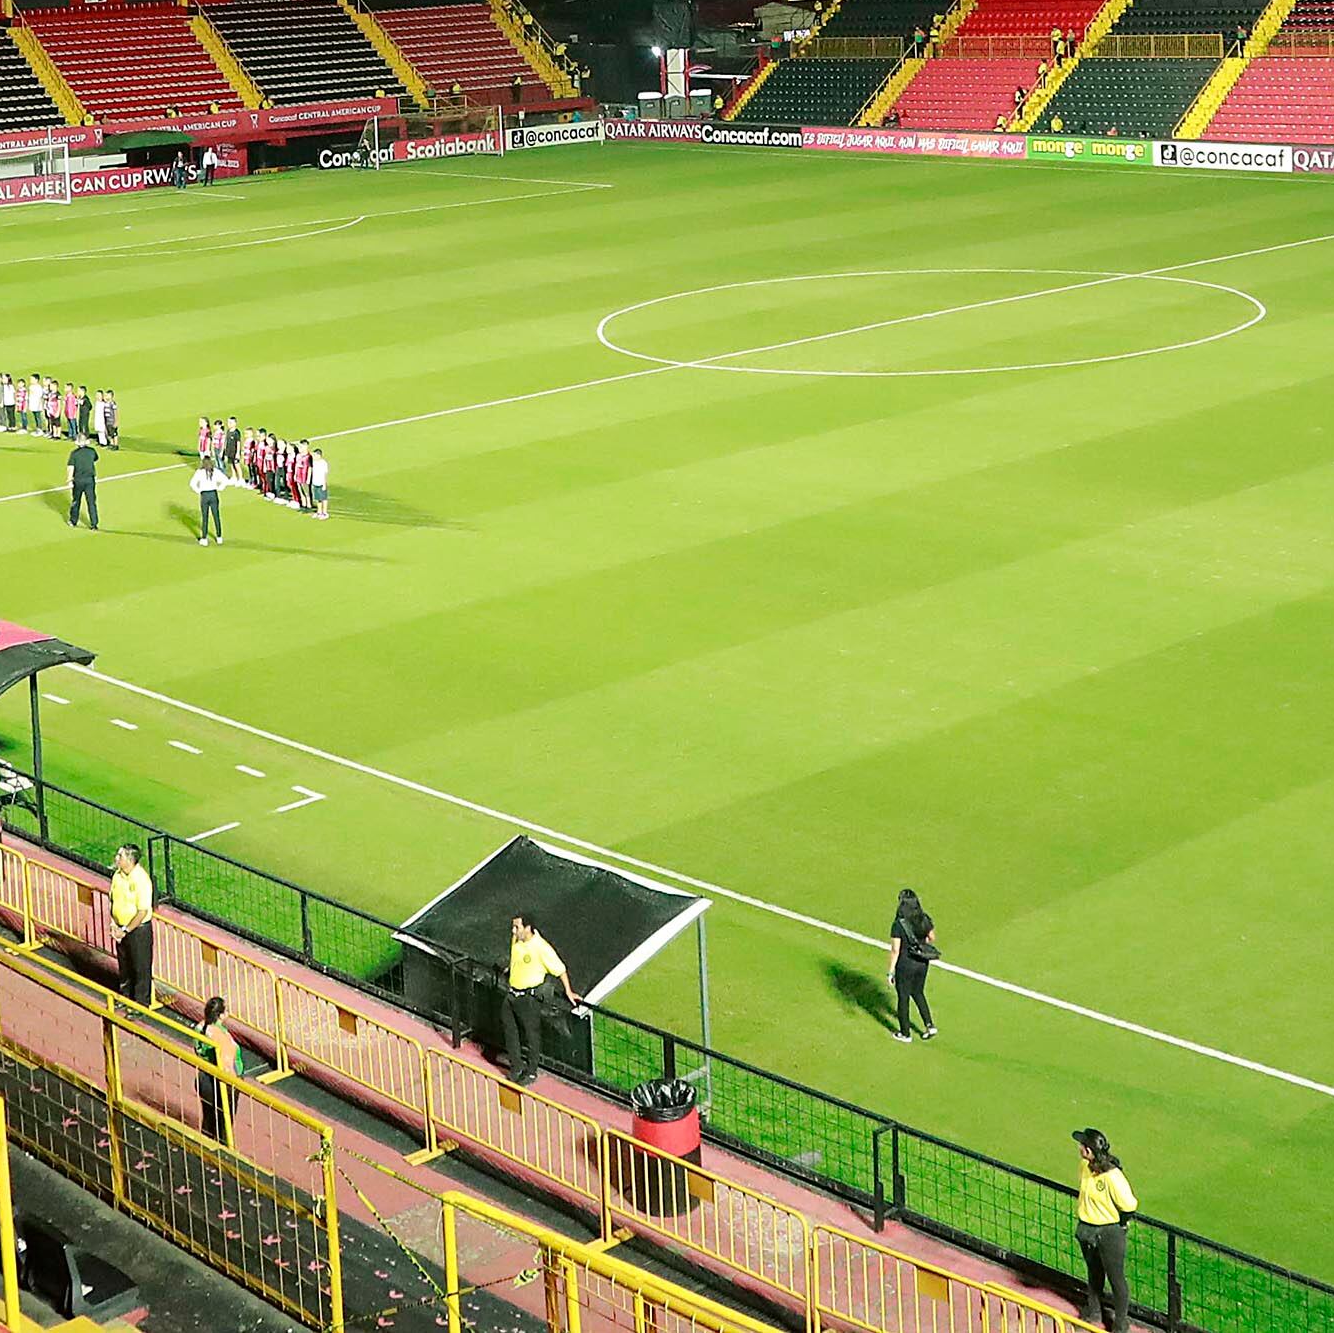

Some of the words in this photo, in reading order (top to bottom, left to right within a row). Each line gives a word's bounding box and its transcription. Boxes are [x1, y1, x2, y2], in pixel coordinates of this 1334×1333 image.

[298, 110, 330, 120] CENTRAL
[331, 107, 366, 116] AMERICAN
[367, 105, 381, 113] CUP
[183, 121, 220, 131] AMERICAN
[222, 120, 237, 129] CUP
[525, 122, 601, 146] @concacaf
[605, 122, 645, 140] QATAR
[648, 123, 702, 140] AIRWAYS
[70, 134, 86, 142] CUP
[406, 133, 496, 160] Scotiabank
[701, 127, 802, 148] Concacaf.com
[845, 135, 873, 148] JUGAR
[1032, 139, 1085, 160] monge
[1091, 141, 1145, 162] monge
[1179, 147, 1285, 169] @concacaf
[109, 173, 142, 190] CUP
